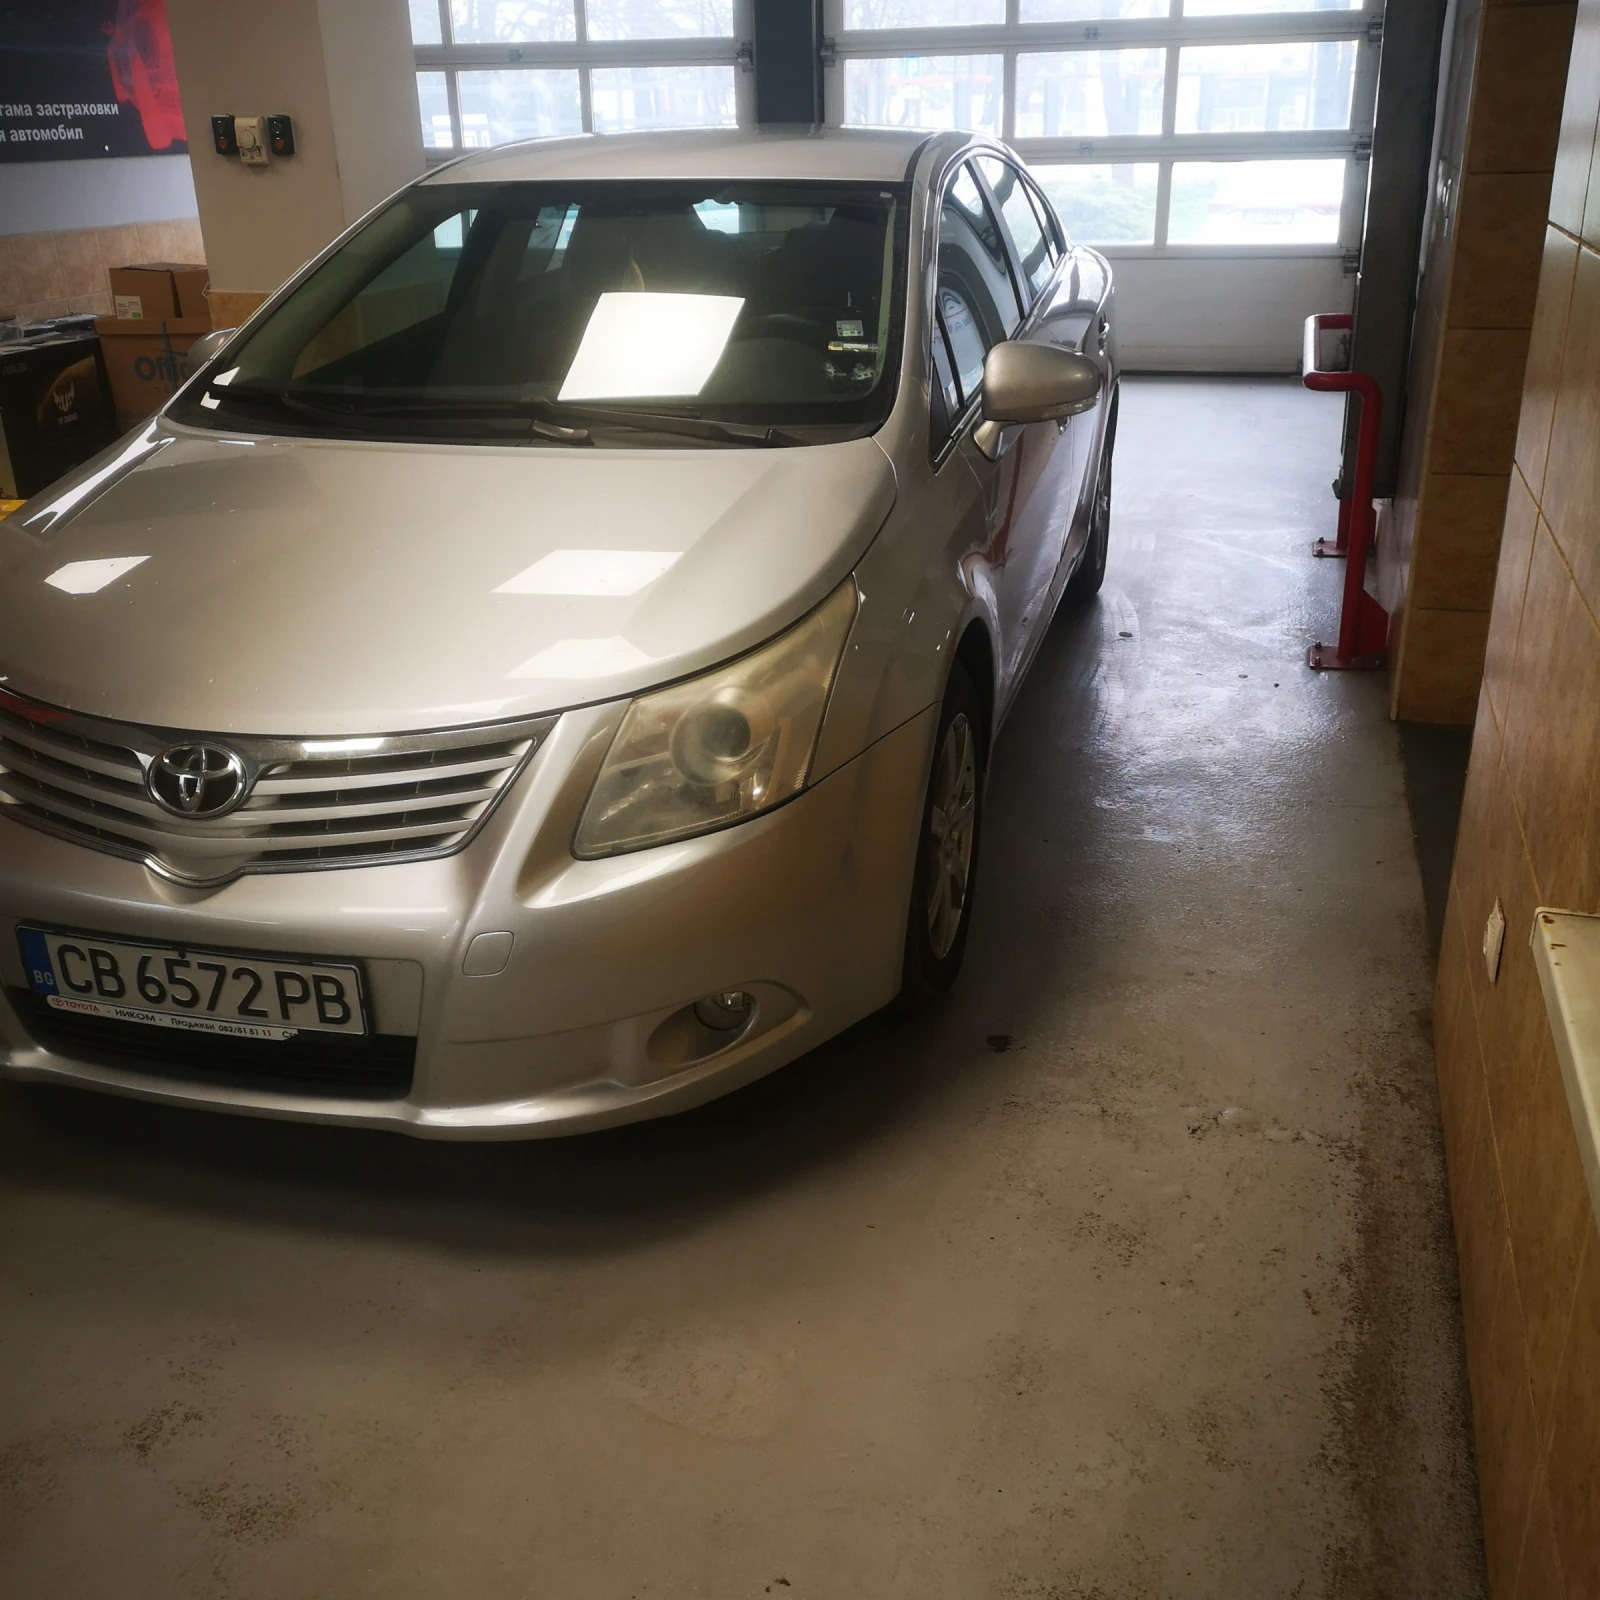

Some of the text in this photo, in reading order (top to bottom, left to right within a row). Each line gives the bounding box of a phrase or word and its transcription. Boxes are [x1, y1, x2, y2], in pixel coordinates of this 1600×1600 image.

[36, 103, 119, 119] застраховки
[10, 124, 84, 142] автомобил
[32, 969, 54, 986] BG
[57, 944, 351, 1025] CB 6572 PB
[64, 1001, 100, 1013] TOYOTA
[115, 1008, 156, 1022] НИКОМ
[218, 1024, 247, 1034] 082/81
